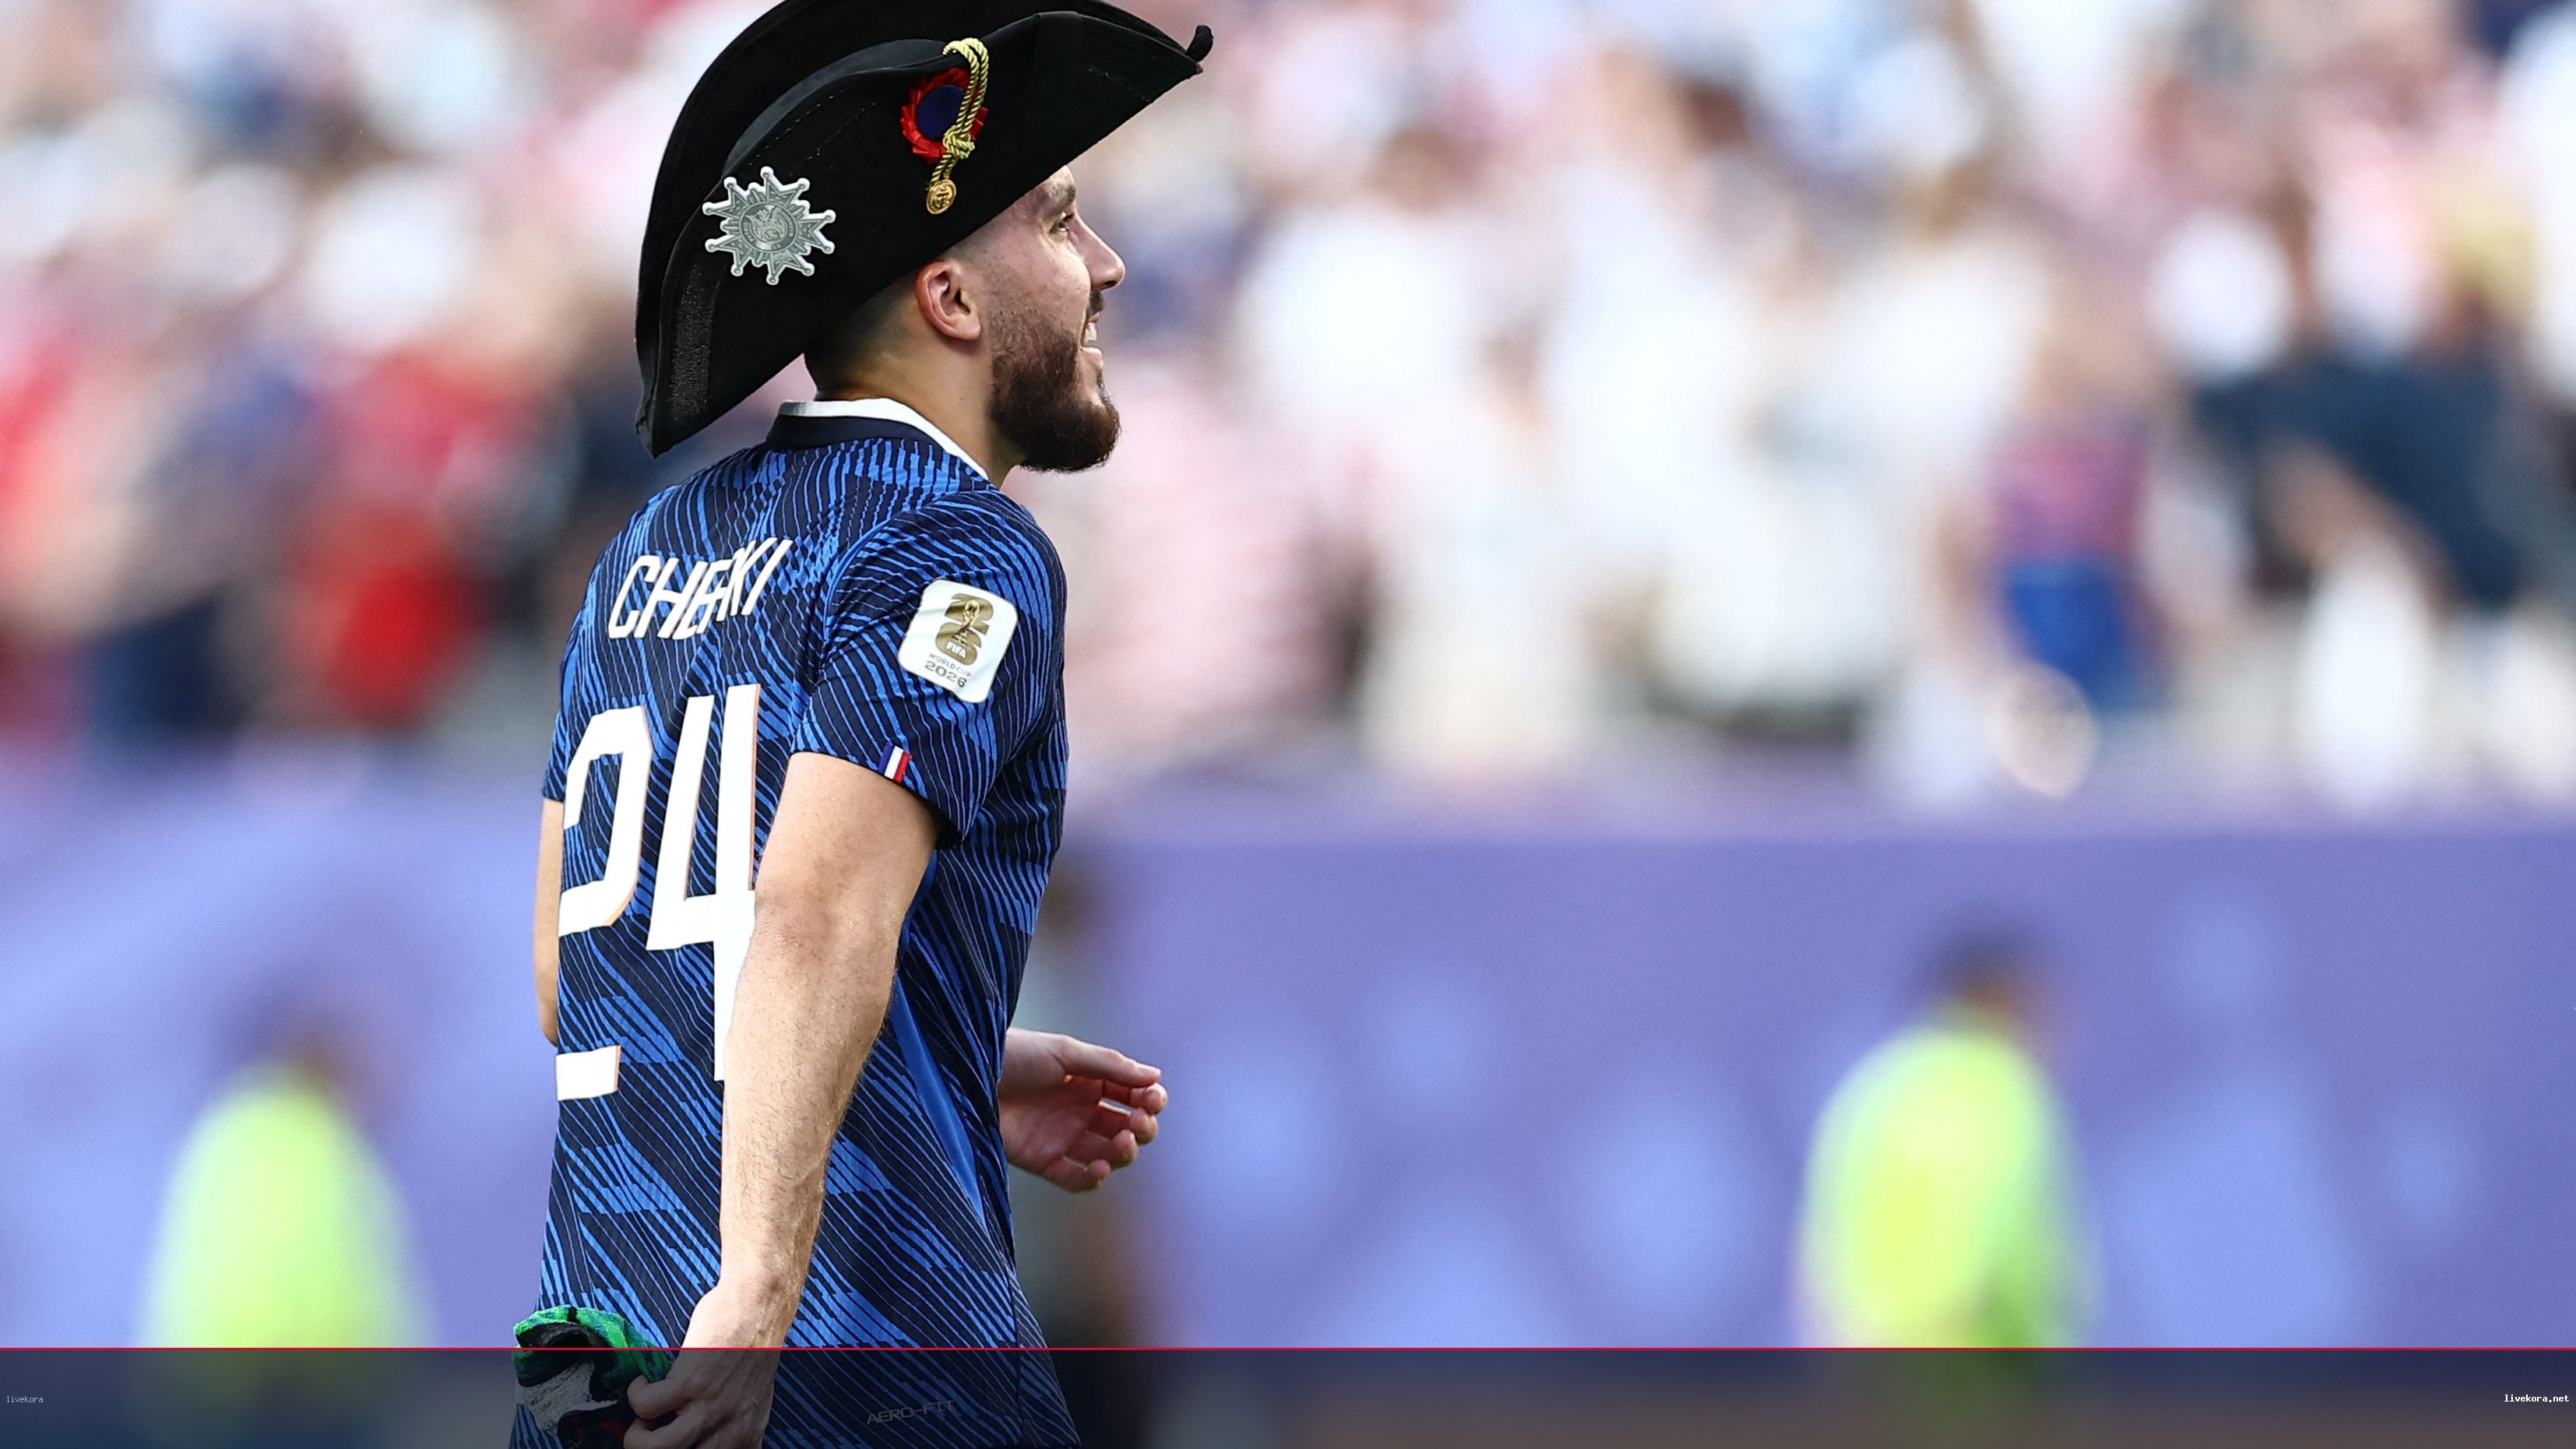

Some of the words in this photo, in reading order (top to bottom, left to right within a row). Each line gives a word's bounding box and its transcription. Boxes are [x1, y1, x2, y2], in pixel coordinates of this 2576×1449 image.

[945, 642, 967, 659] FIFA
[924, 660, 967, 688] 2026
[929, 653, 955, 670] WORLD
[956, 665, 971, 677] CUP
[556, 684, 761, 1101] 24
[867, 1401, 955, 1424] AERO-FIT
